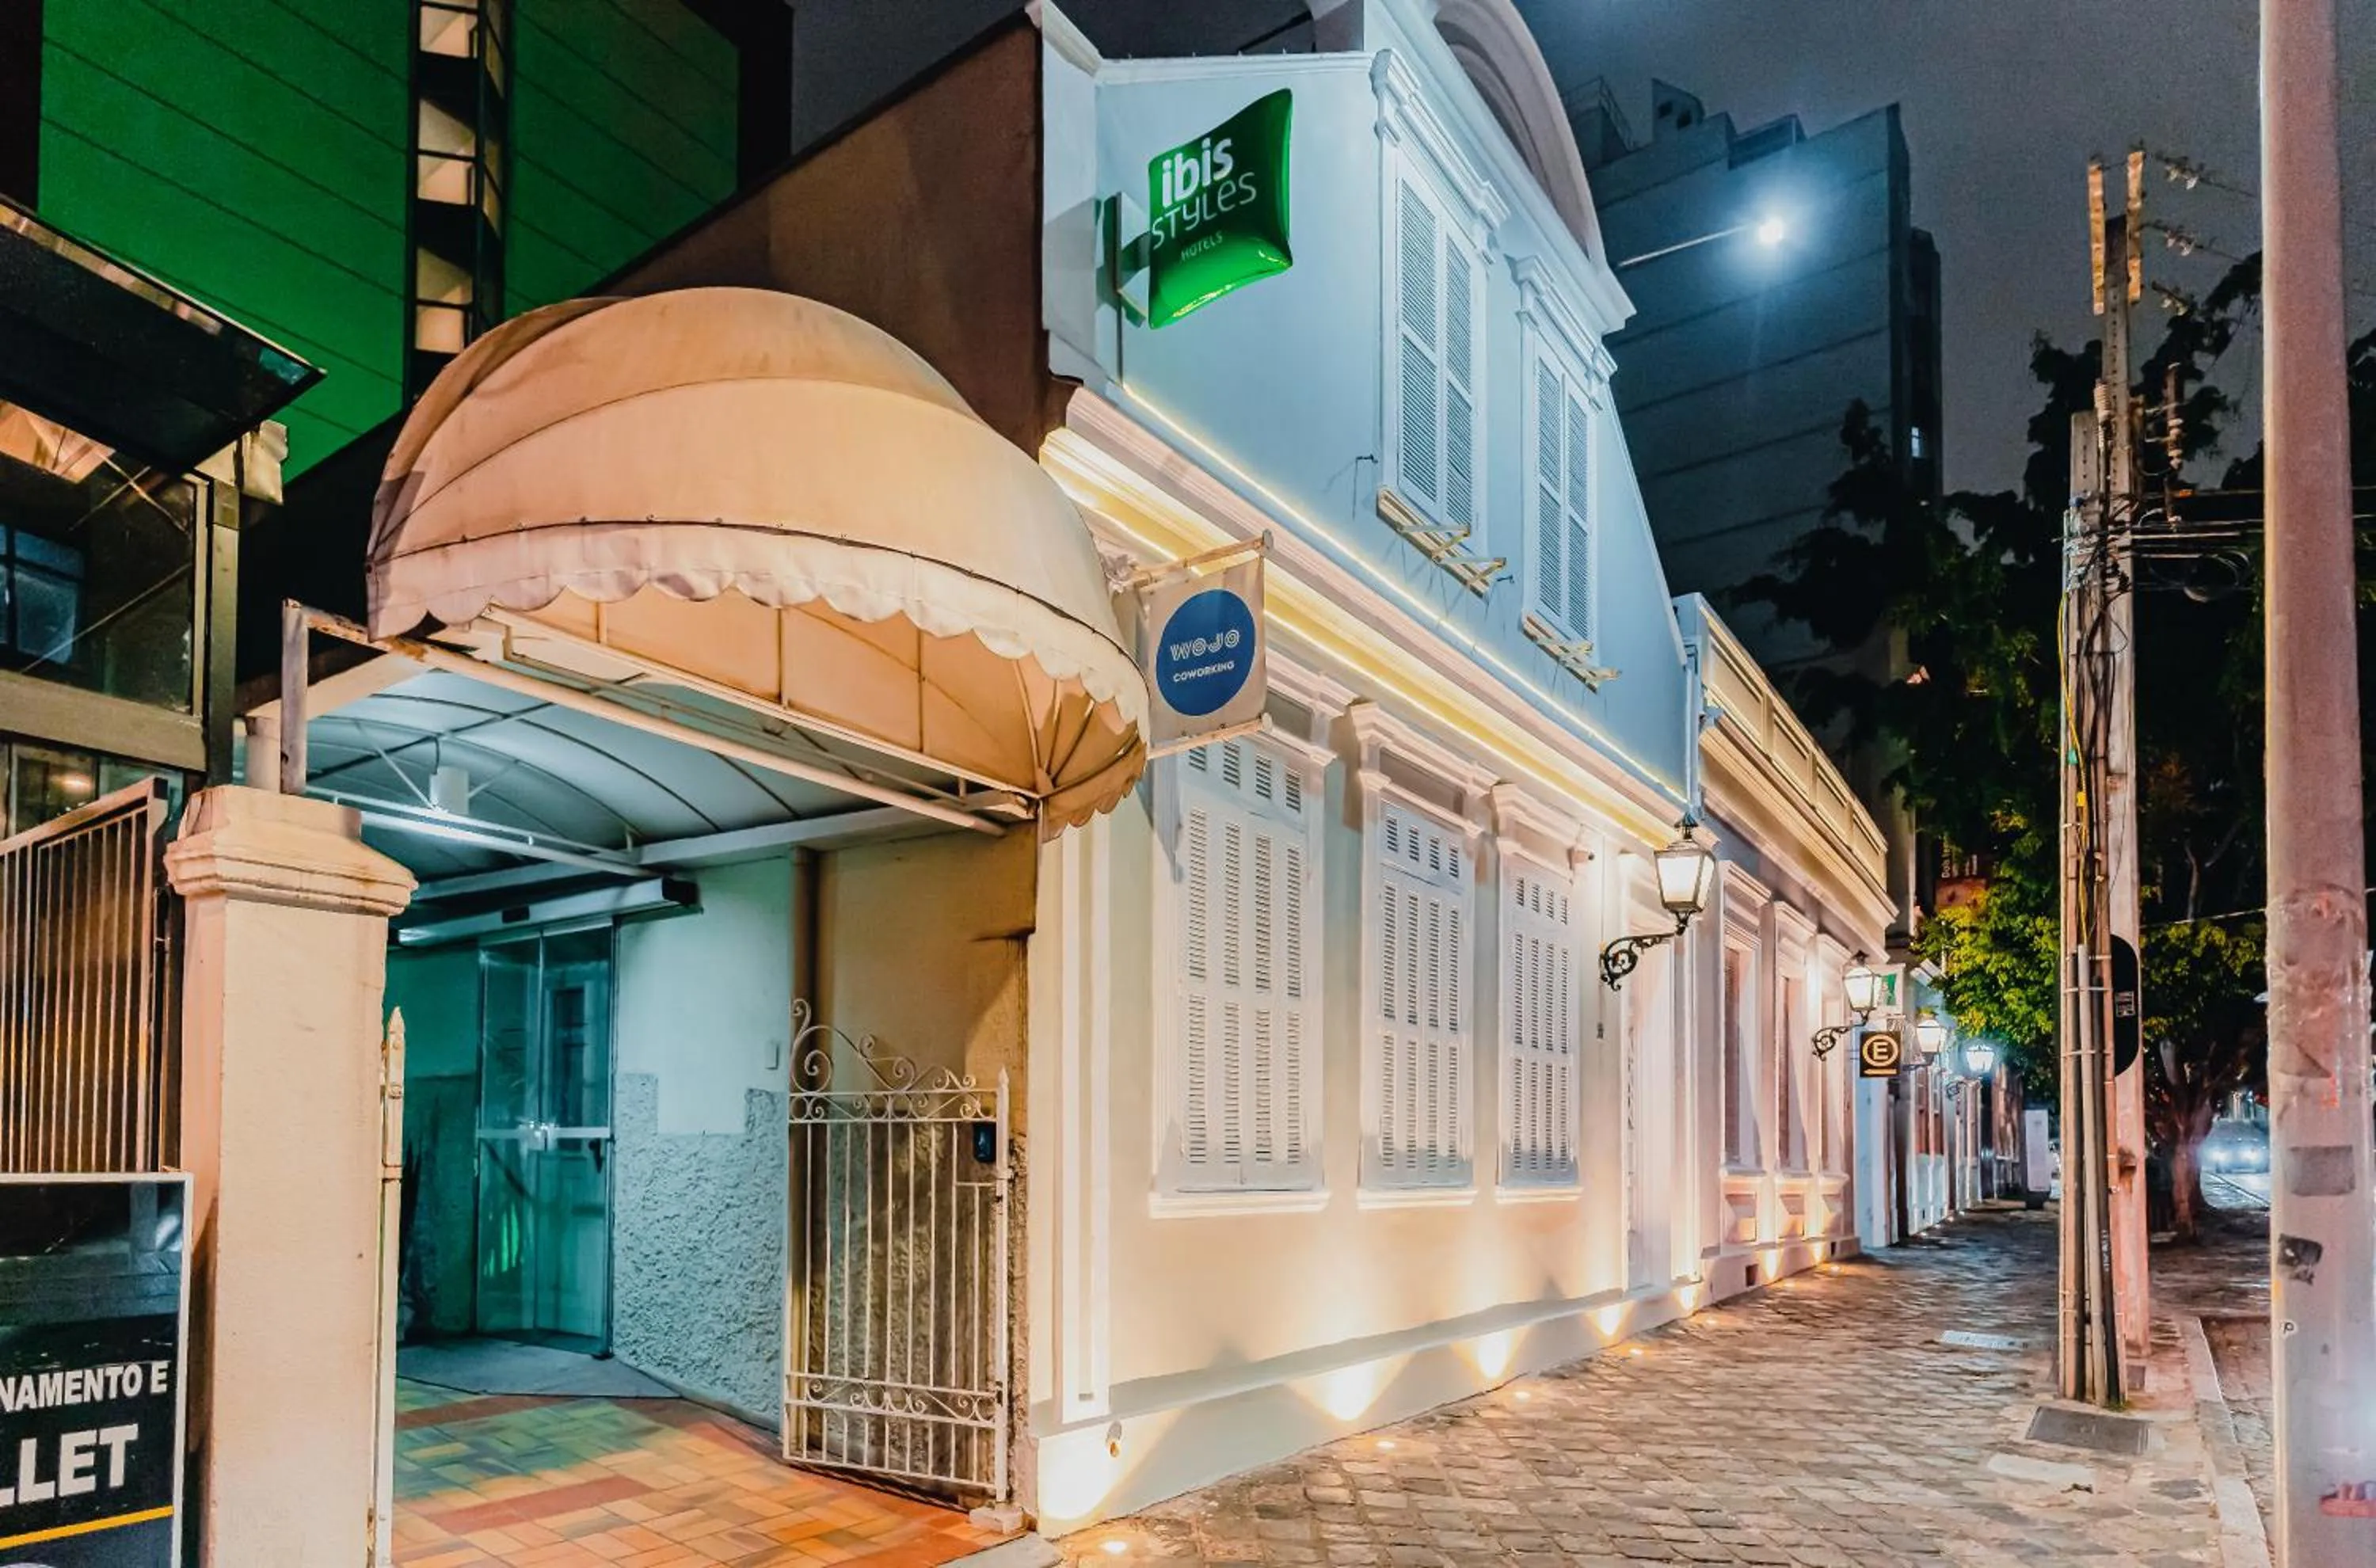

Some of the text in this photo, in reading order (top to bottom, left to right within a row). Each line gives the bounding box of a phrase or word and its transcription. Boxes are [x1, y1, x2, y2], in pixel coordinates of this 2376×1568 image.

[1162, 138, 1233, 207] ibis
[1180, 230, 1223, 263] HOTELS
[1170, 630, 1239, 660] WOJO
[1173, 660, 1235, 682] COWORKING
[1872, 1041, 1889, 1060] E
[150, 1360, 169, 1394] E
